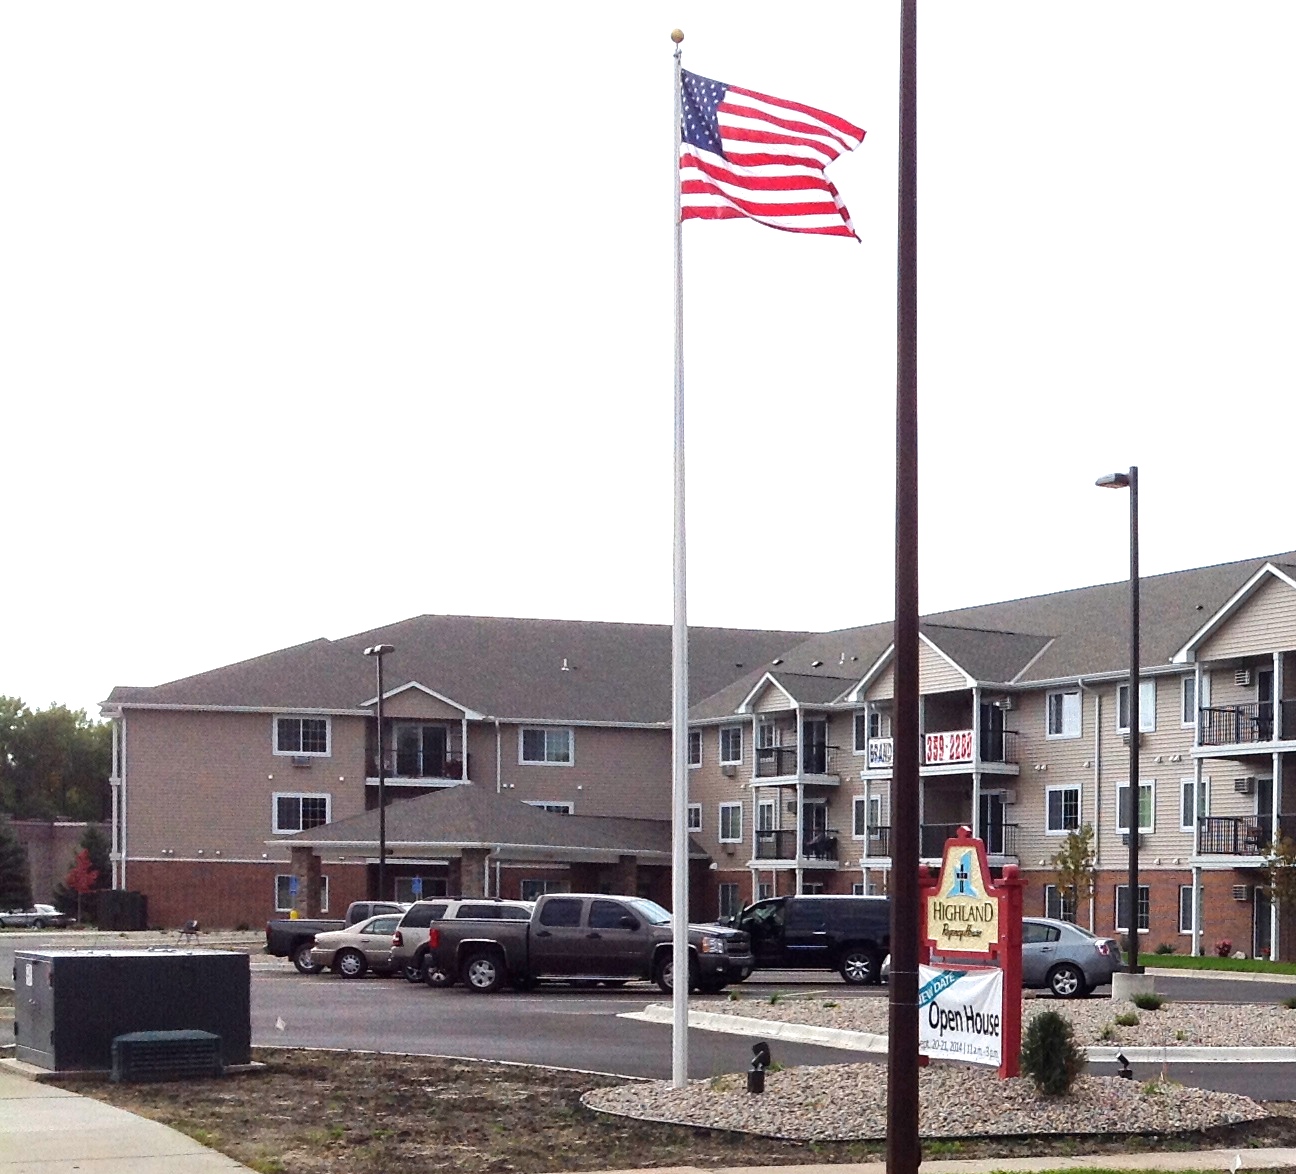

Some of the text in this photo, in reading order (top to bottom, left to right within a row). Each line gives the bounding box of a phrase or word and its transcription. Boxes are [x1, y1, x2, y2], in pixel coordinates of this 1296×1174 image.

[933, 902, 994, 922] HIGHLAND
[933, 972, 956, 994] DATE
[929, 1001, 1000, 1037] Open House
